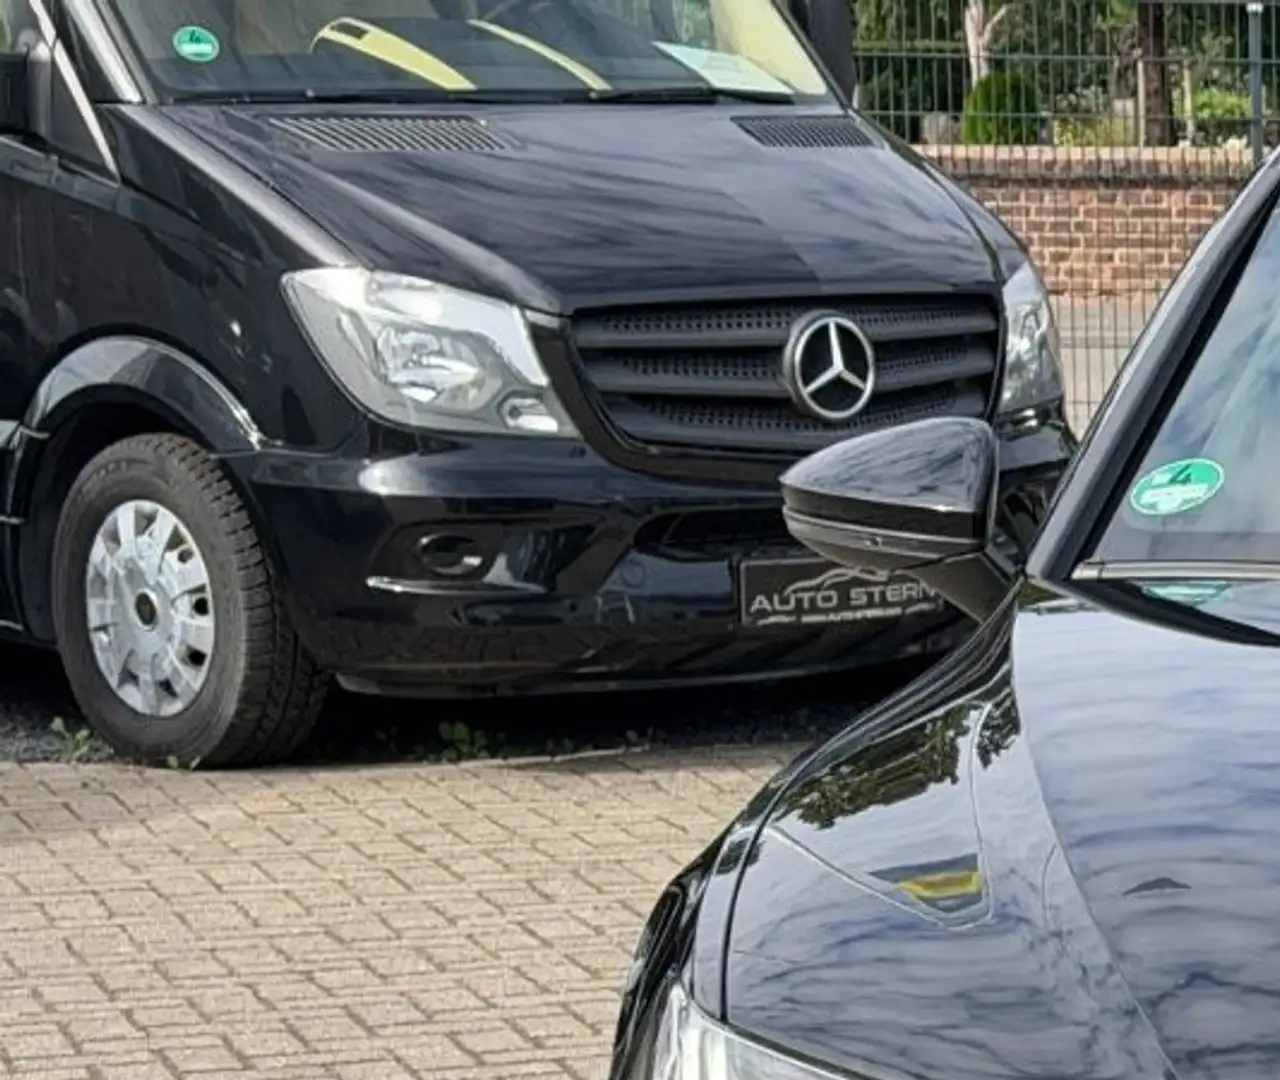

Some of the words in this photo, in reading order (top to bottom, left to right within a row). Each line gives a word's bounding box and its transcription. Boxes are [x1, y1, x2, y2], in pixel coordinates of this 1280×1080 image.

[1167, 463, 1193, 485] 4
[750, 590, 838, 613] AUTO
[850, 583, 936, 606] STERN
